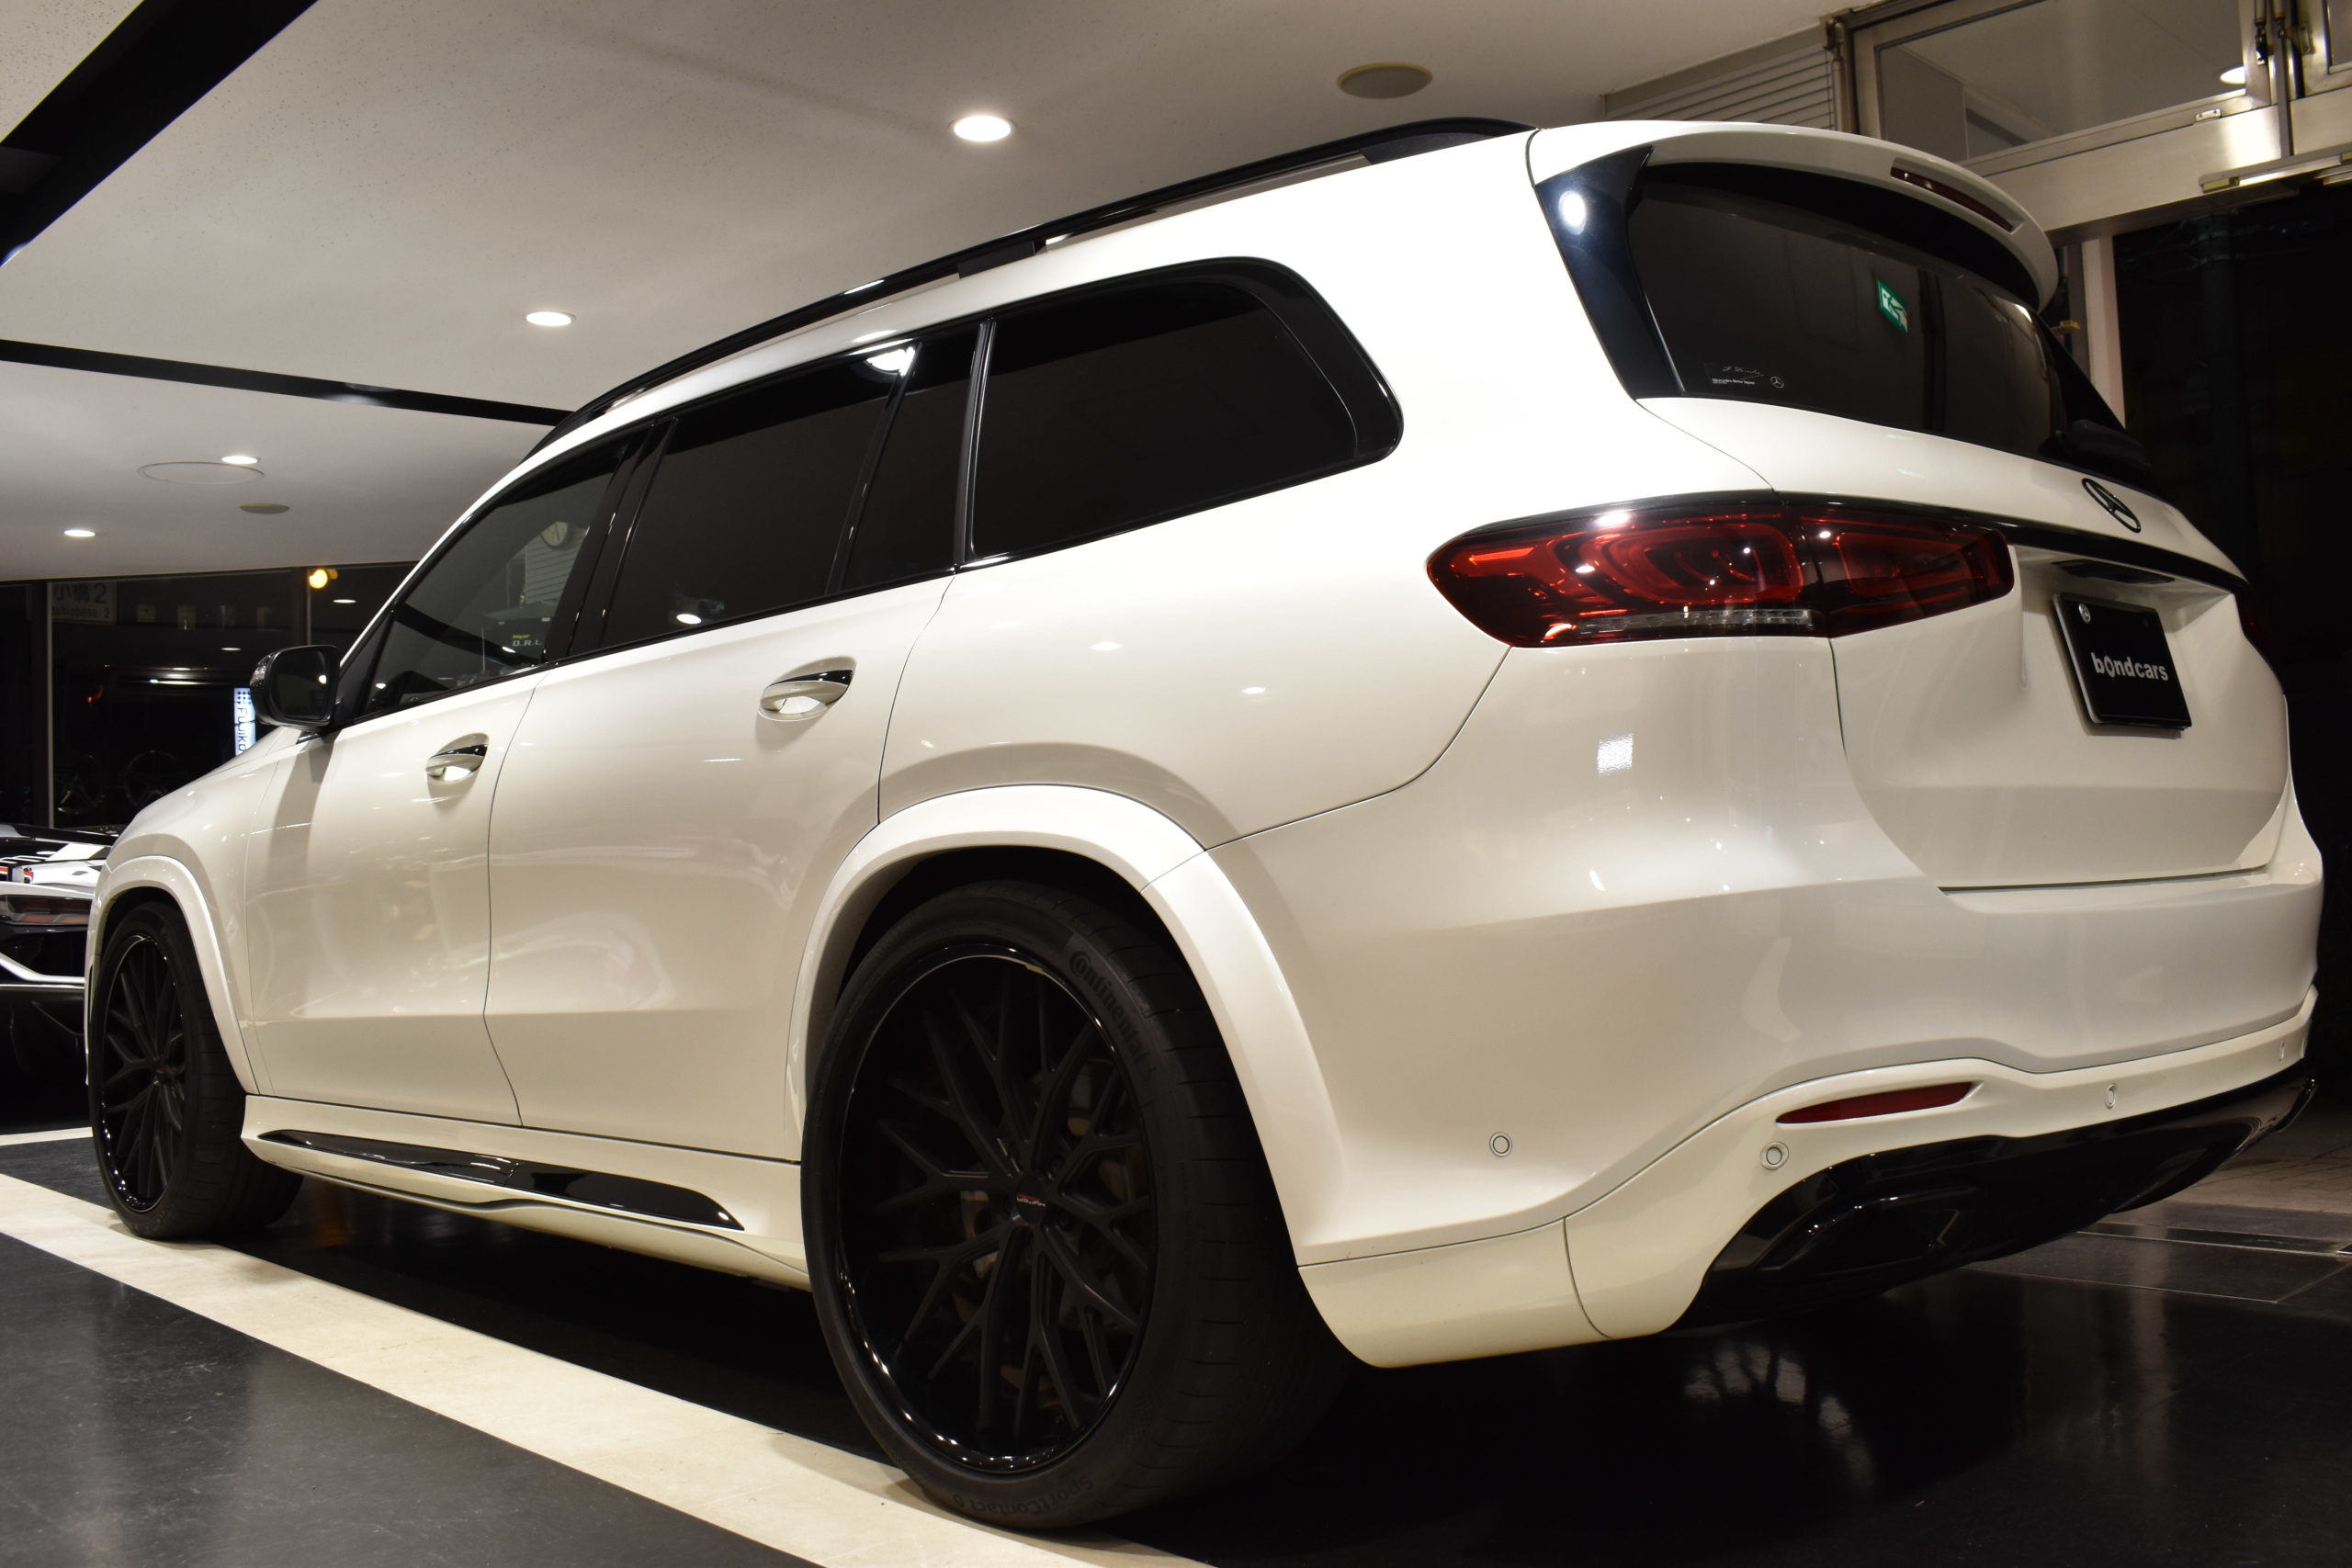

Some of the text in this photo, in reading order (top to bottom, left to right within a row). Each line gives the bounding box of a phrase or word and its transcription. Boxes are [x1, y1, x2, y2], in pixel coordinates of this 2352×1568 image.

[104, 607, 110, 618] 2
[2090, 650, 2169, 682] bondcars
[1069, 950, 1151, 1066] Continental
[968, 1473, 1095, 1517] SportContact
